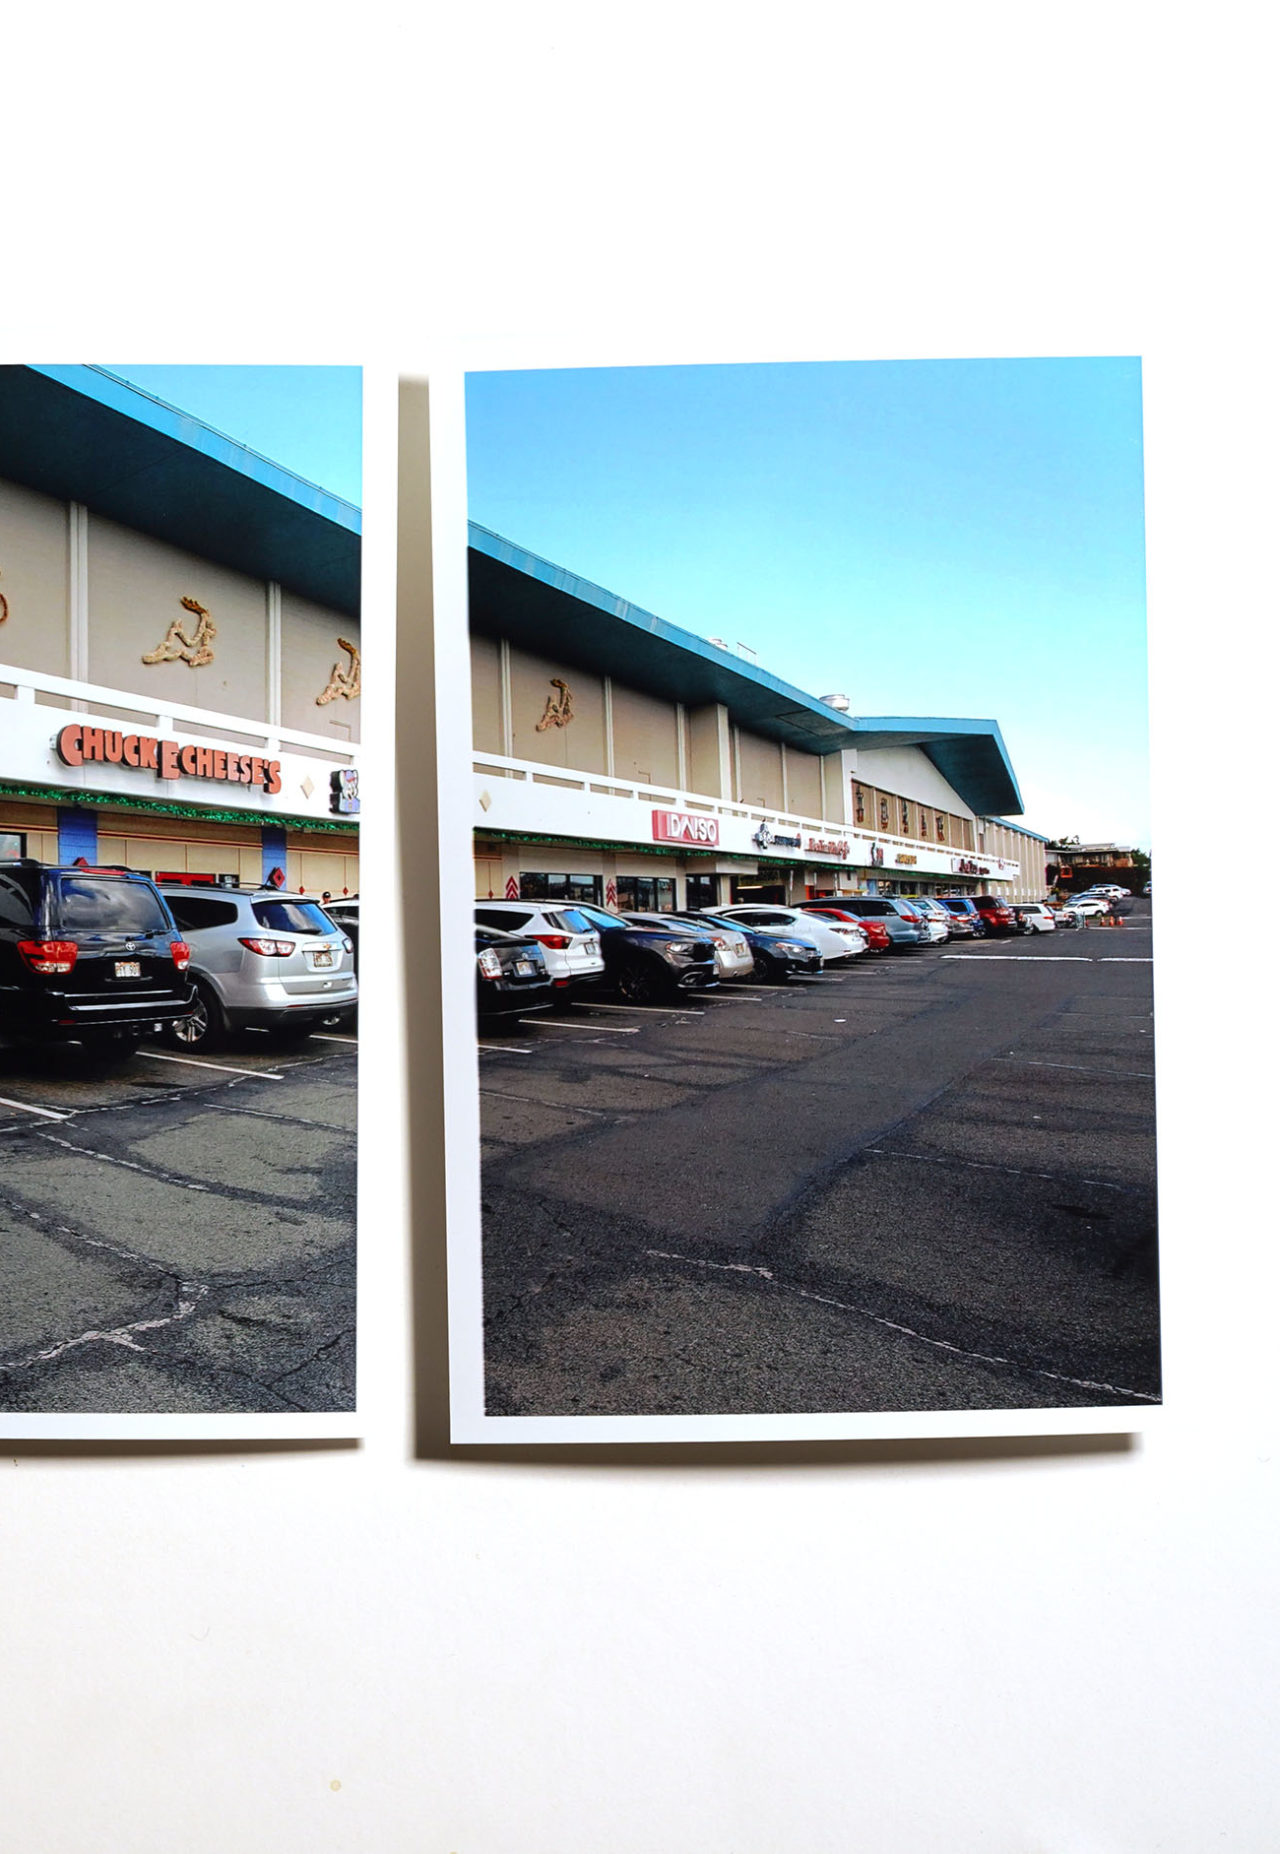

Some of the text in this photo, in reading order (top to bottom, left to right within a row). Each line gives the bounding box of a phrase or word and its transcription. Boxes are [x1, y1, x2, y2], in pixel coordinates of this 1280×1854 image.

[58, 724, 282, 794] CHUCK E CHEESE'S
[667, 813, 717, 842] DAISO
